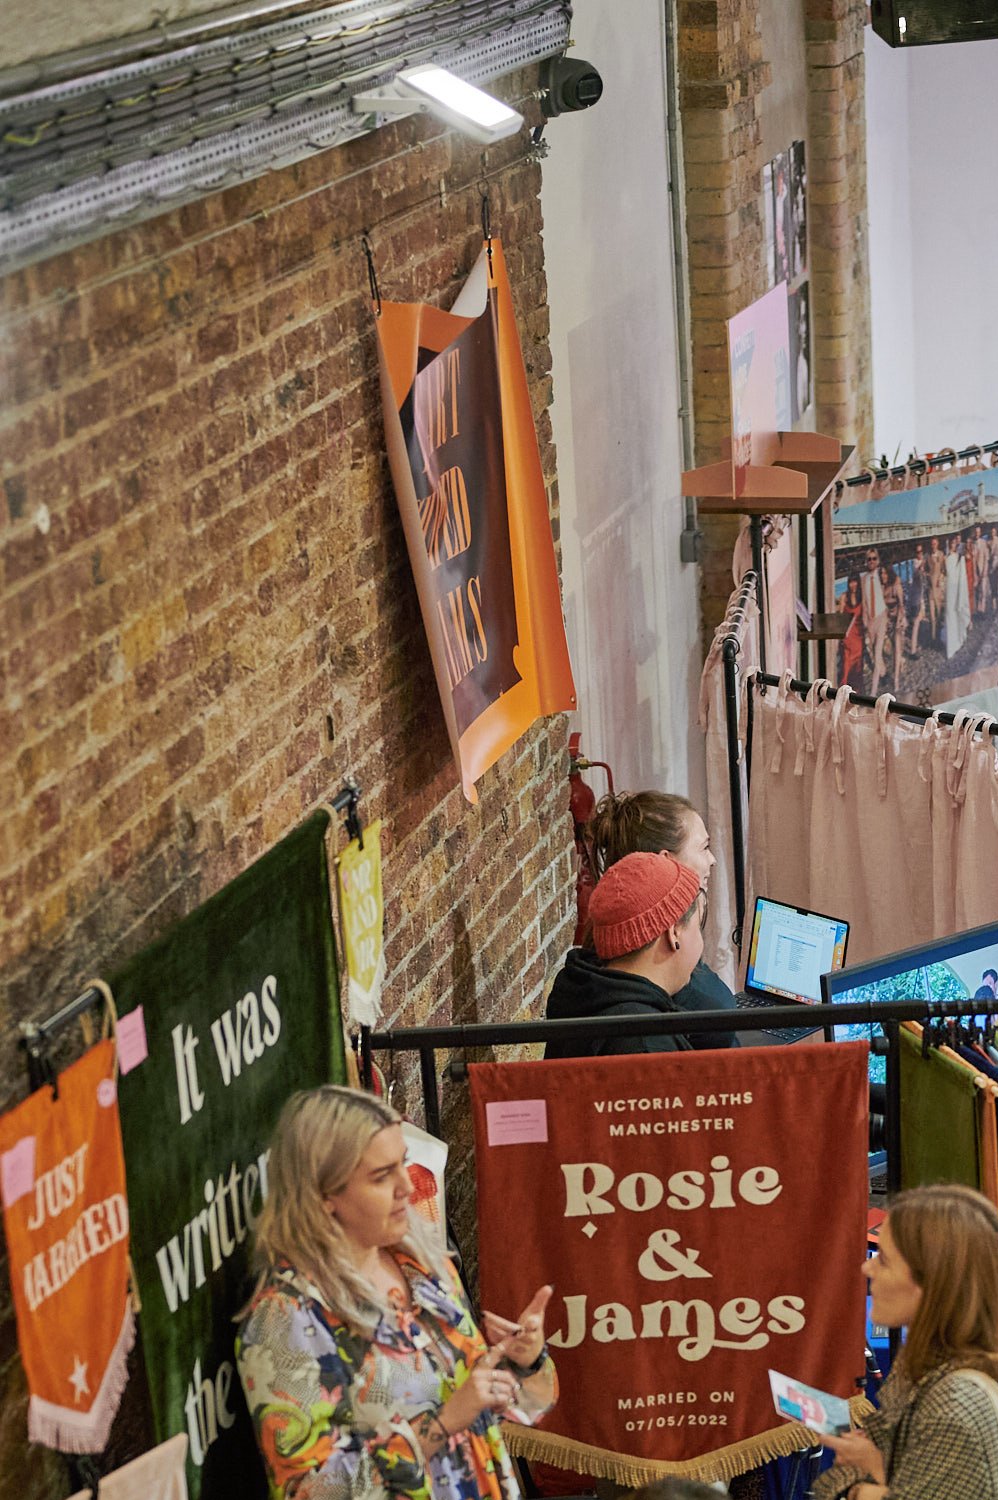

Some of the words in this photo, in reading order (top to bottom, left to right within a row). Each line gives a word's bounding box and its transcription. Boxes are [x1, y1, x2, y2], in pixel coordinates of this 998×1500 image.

[172, 1023, 204, 1125] It
[211, 975, 281, 1086] was
[594, 1096, 684, 1114] VICTORIA
[695, 1091, 753, 1107] BATHS
[609, 1117, 735, 1137] MANCHESTER
[28, 1142, 89, 1231] JUST
[560, 1155, 783, 1218] Rosie
[638, 1228, 713, 1281] &
[547, 1295, 806, 1362] James
[185, 1358, 235, 1466] the
[617, 1391, 698, 1410] MARRIED
[709, 1391, 735, 1403] ON
[625, 1414, 728, 1431] 07/05/2022
